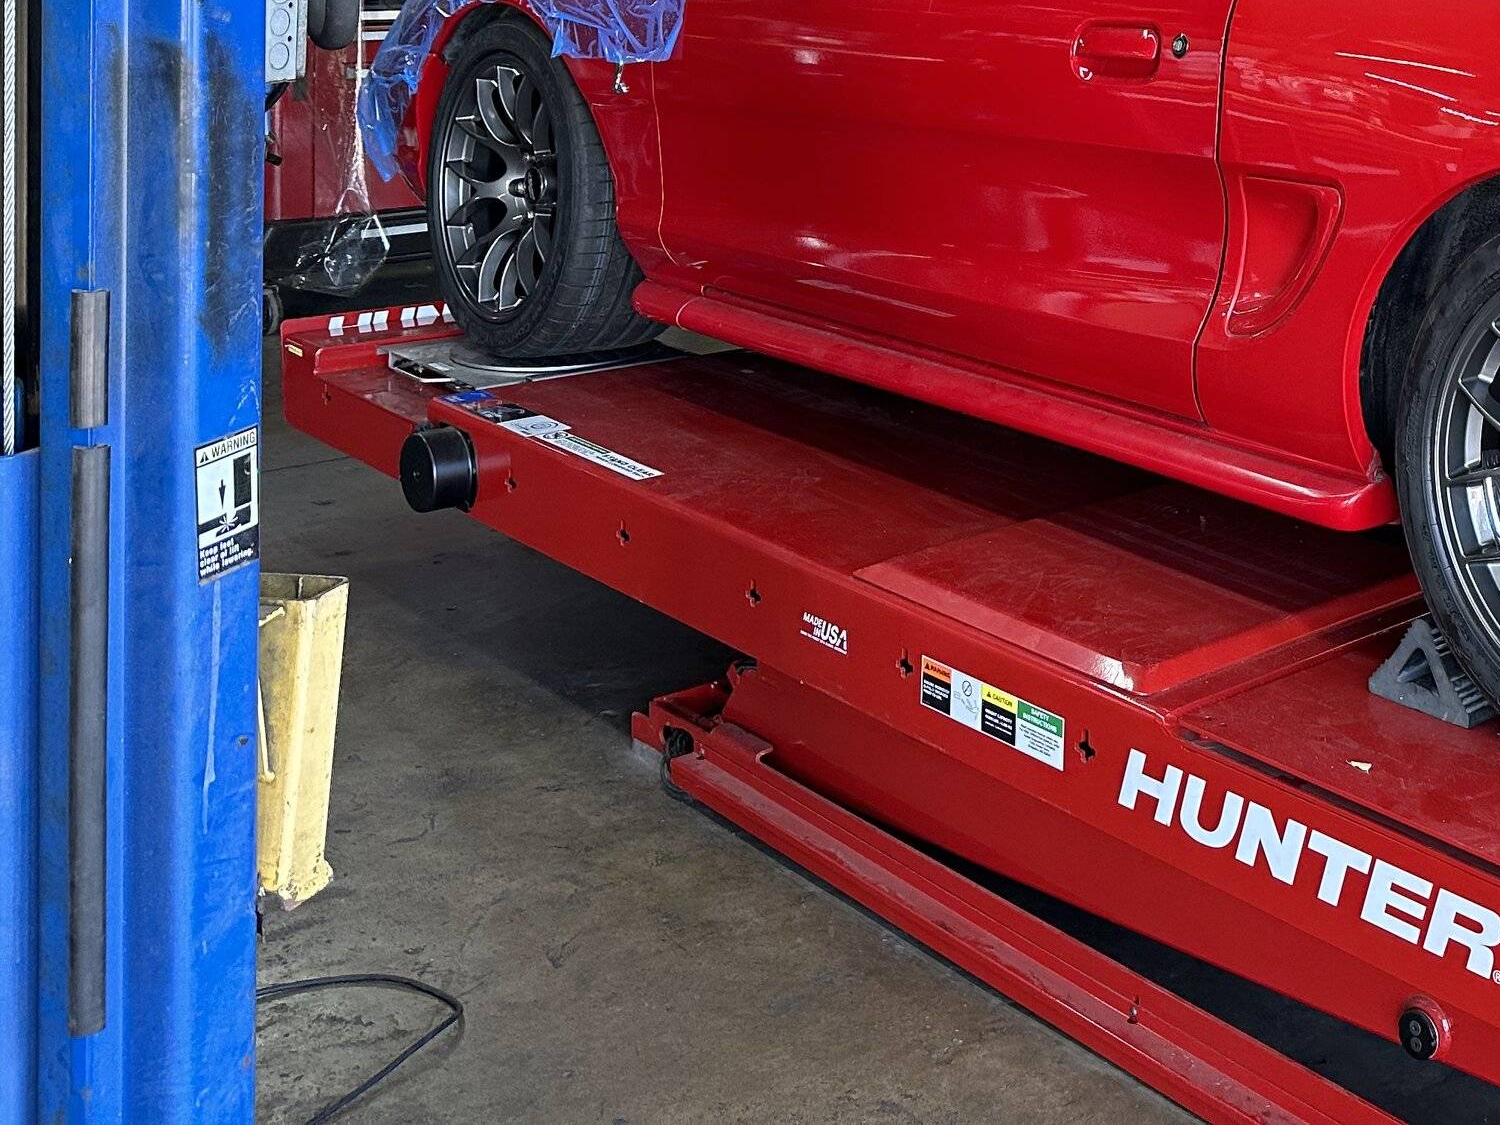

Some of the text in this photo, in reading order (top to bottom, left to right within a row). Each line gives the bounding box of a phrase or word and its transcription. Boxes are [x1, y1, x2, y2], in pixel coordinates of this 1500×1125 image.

[211, 431, 255, 458] WARNING
[200, 545, 218, 560] Keep
[200, 554, 218, 568] clear
[803, 612, 823, 628] MADE
[821, 620, 847, 650] USA
